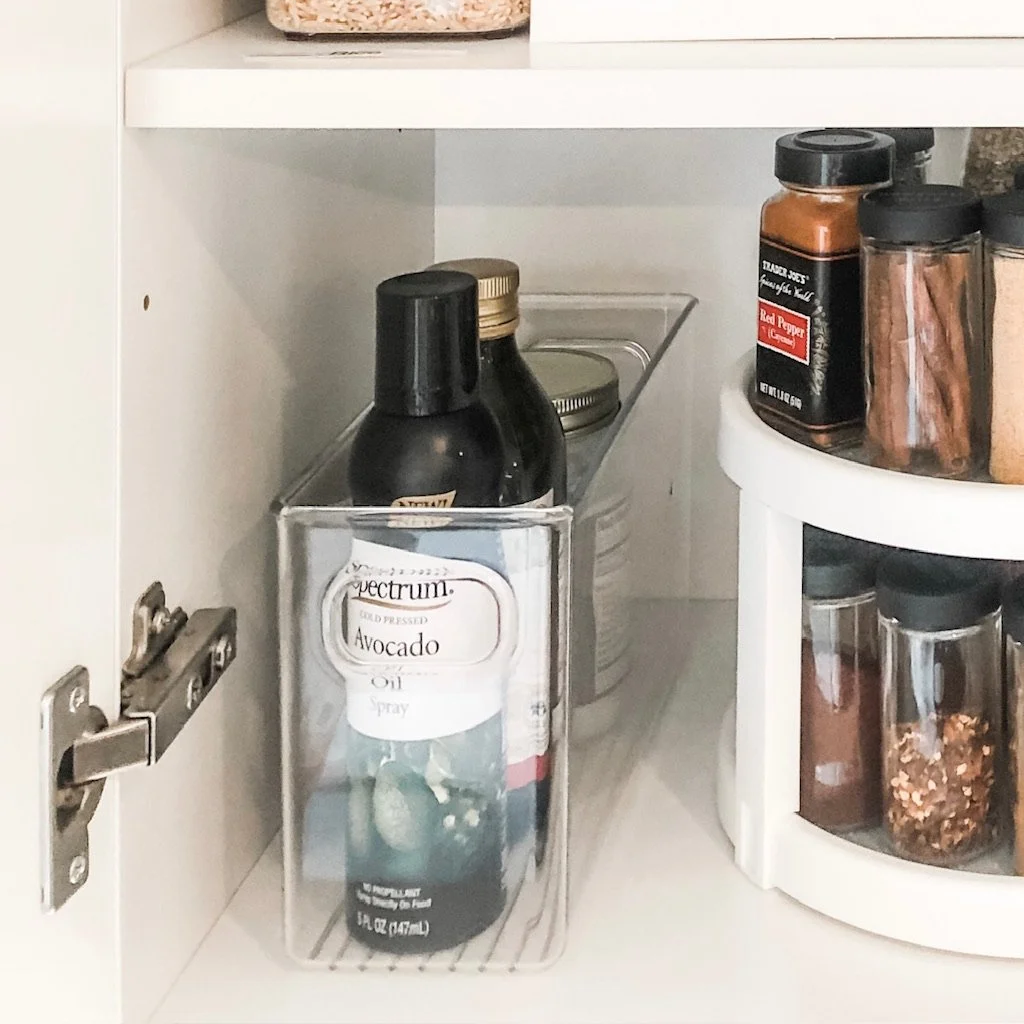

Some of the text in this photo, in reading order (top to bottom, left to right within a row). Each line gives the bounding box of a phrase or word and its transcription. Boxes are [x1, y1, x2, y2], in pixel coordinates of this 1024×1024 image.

[763, 260, 788, 278] TRADER
[760, 309, 805, 338] Red Pepper
[384, 616, 428, 626] PRESSED
[355, 626, 440, 657] Avocado
[371, 676, 402, 690] Oil
[370, 697, 410, 718] Spray
[374, 918, 387, 935] OZ
